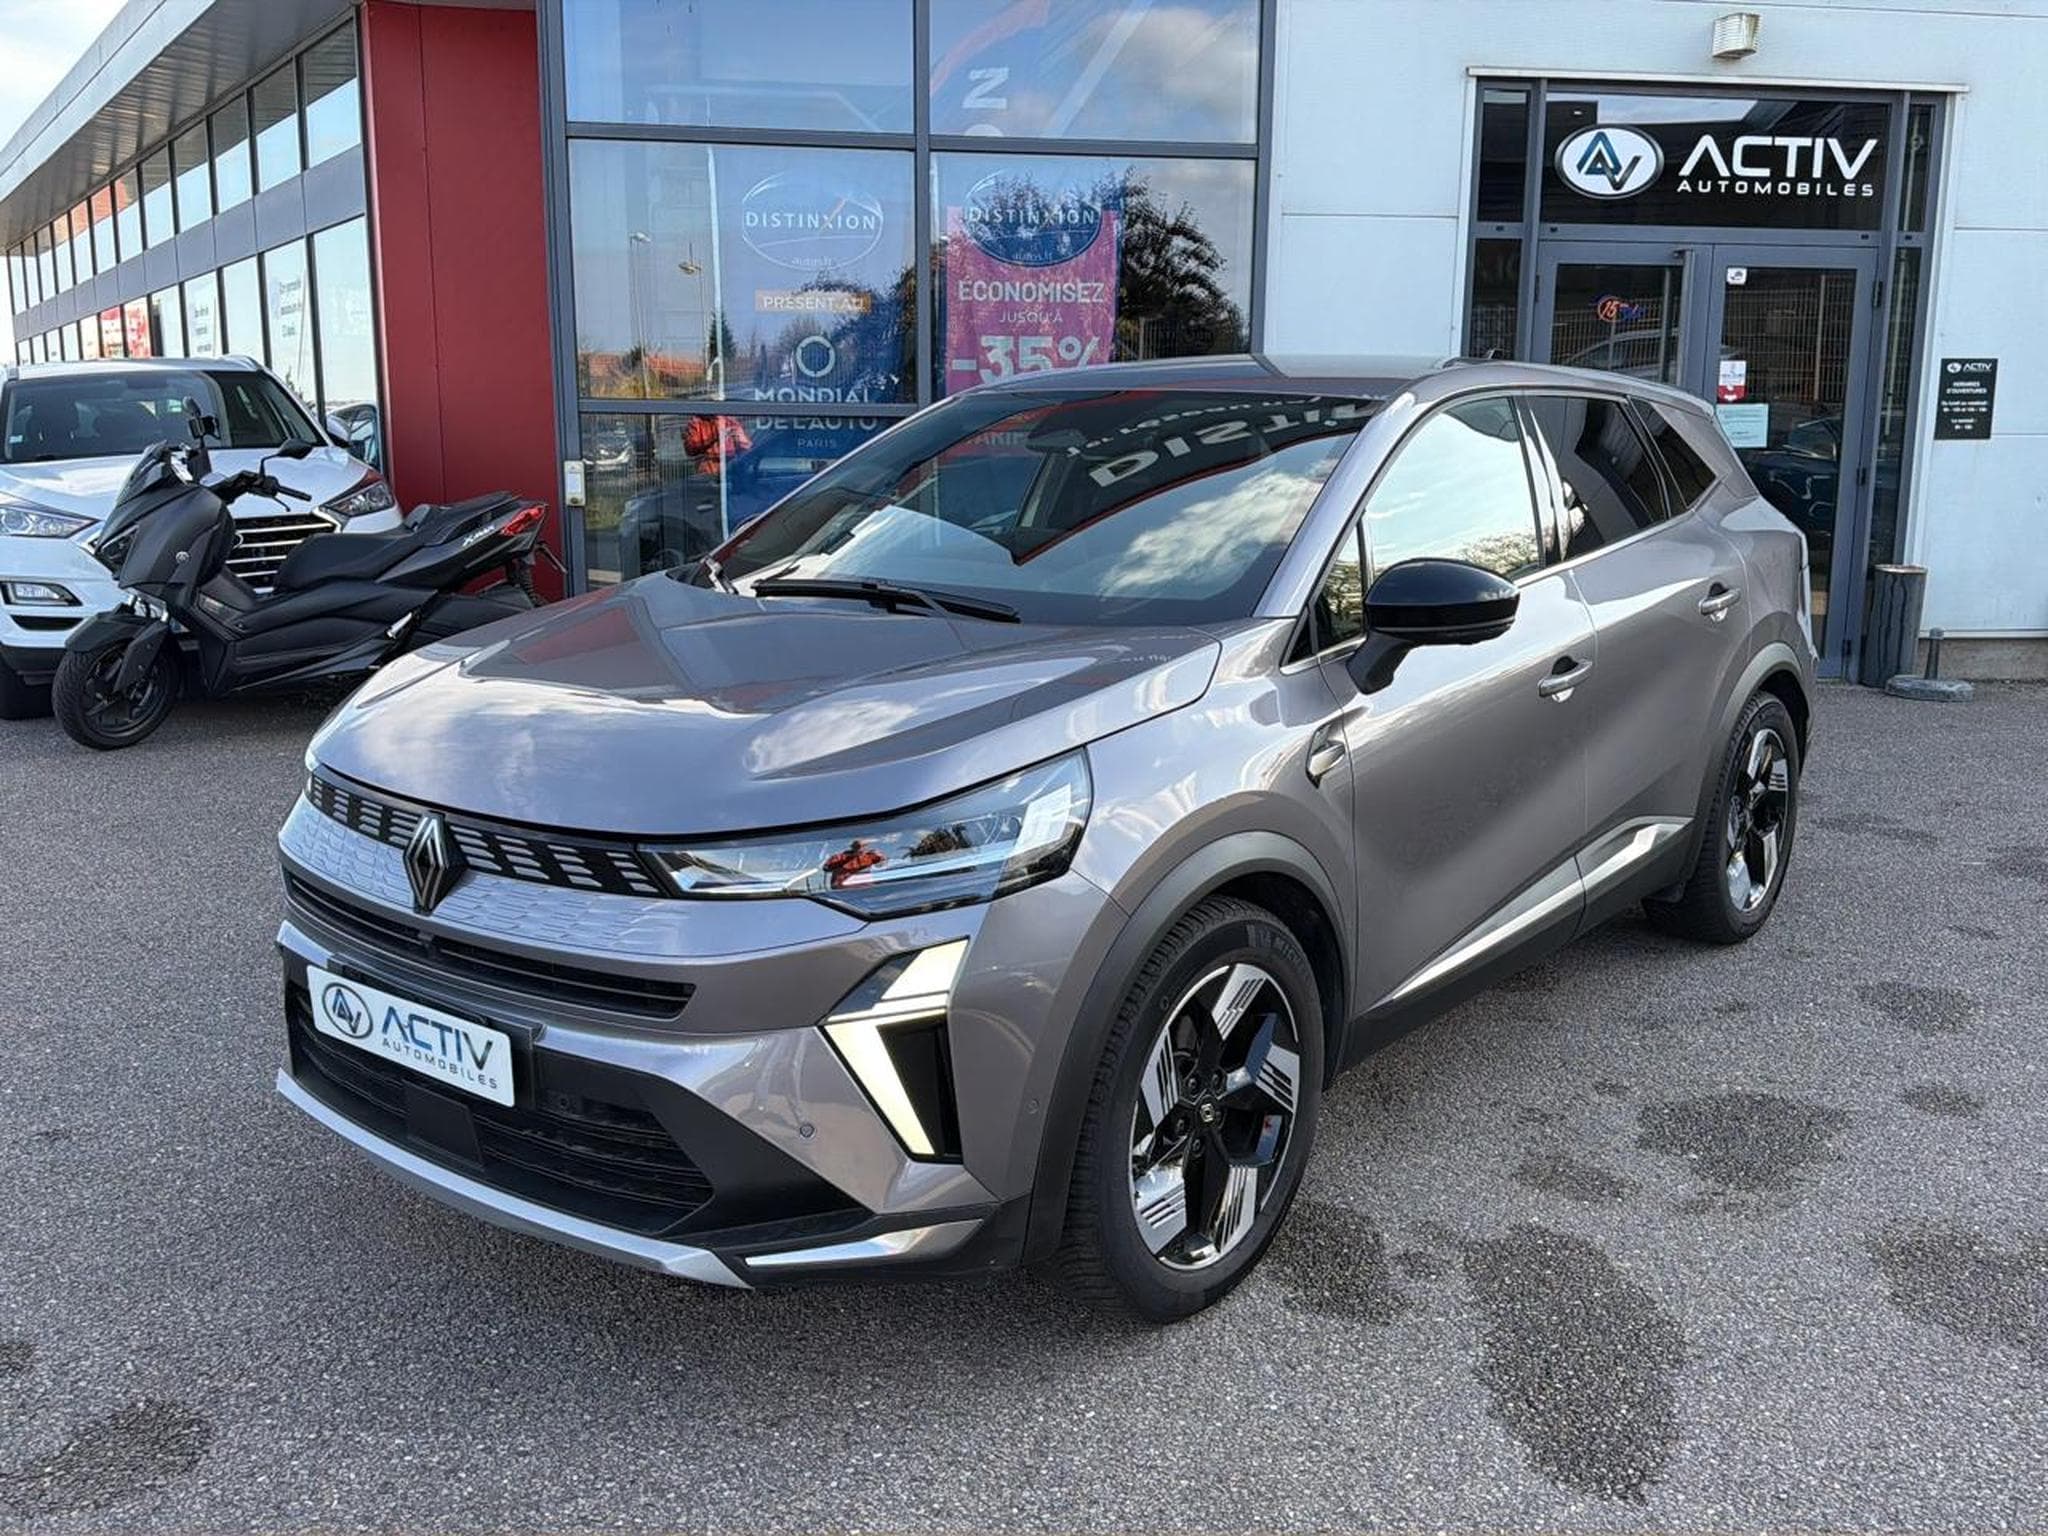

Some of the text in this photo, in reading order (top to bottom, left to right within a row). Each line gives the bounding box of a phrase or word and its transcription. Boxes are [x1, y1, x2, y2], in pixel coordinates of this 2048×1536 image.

[1678, 134, 1878, 180] ACTIV
[1677, 179, 1874, 197] AUTOMOBILES
[745, 207, 875, 231] DISTINXION
[968, 205, 1094, 226] DISTINXION
[382, 1006, 493, 1071] ACTIV
[382, 1038, 498, 1090] AUTOMOBILES
